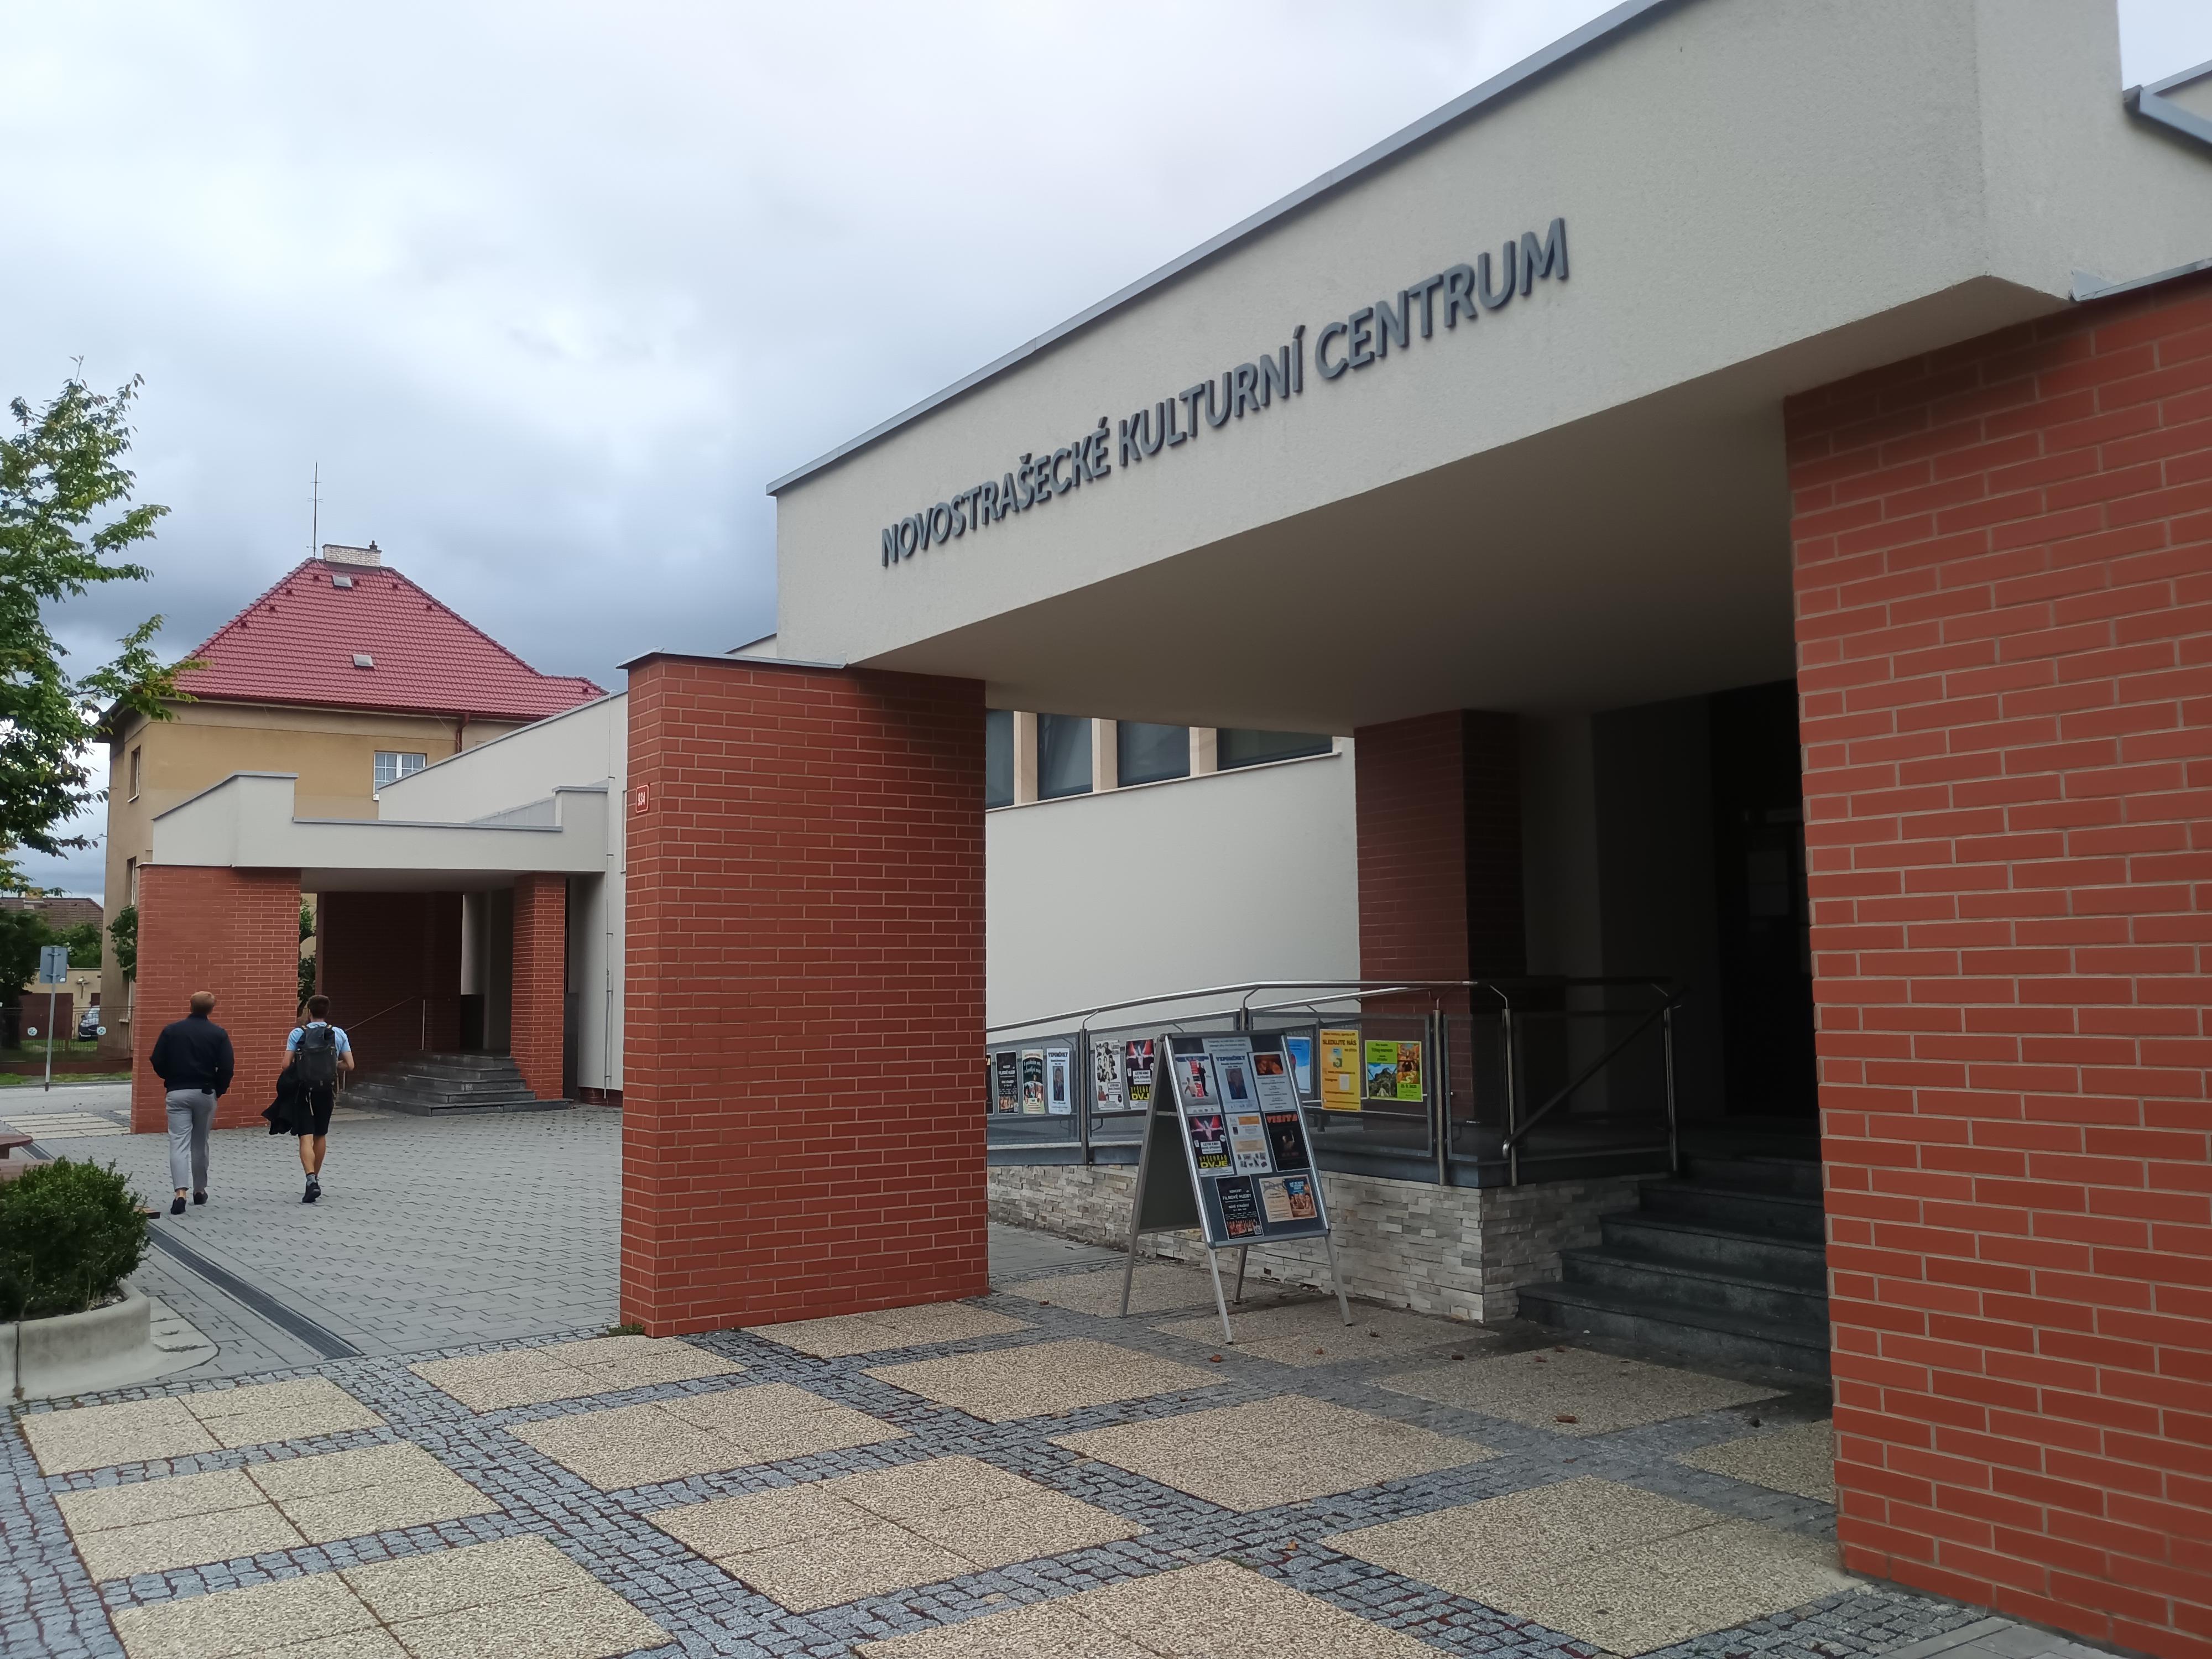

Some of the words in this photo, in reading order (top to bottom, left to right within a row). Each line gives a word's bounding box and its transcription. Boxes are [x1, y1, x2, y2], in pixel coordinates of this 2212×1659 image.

[881, 416, 1111, 567] NOVOSTRAŠECKÉ
[1119, 325, 1306, 467] KULTURNÍ
[1315, 217, 1569, 379] CENTRUM
